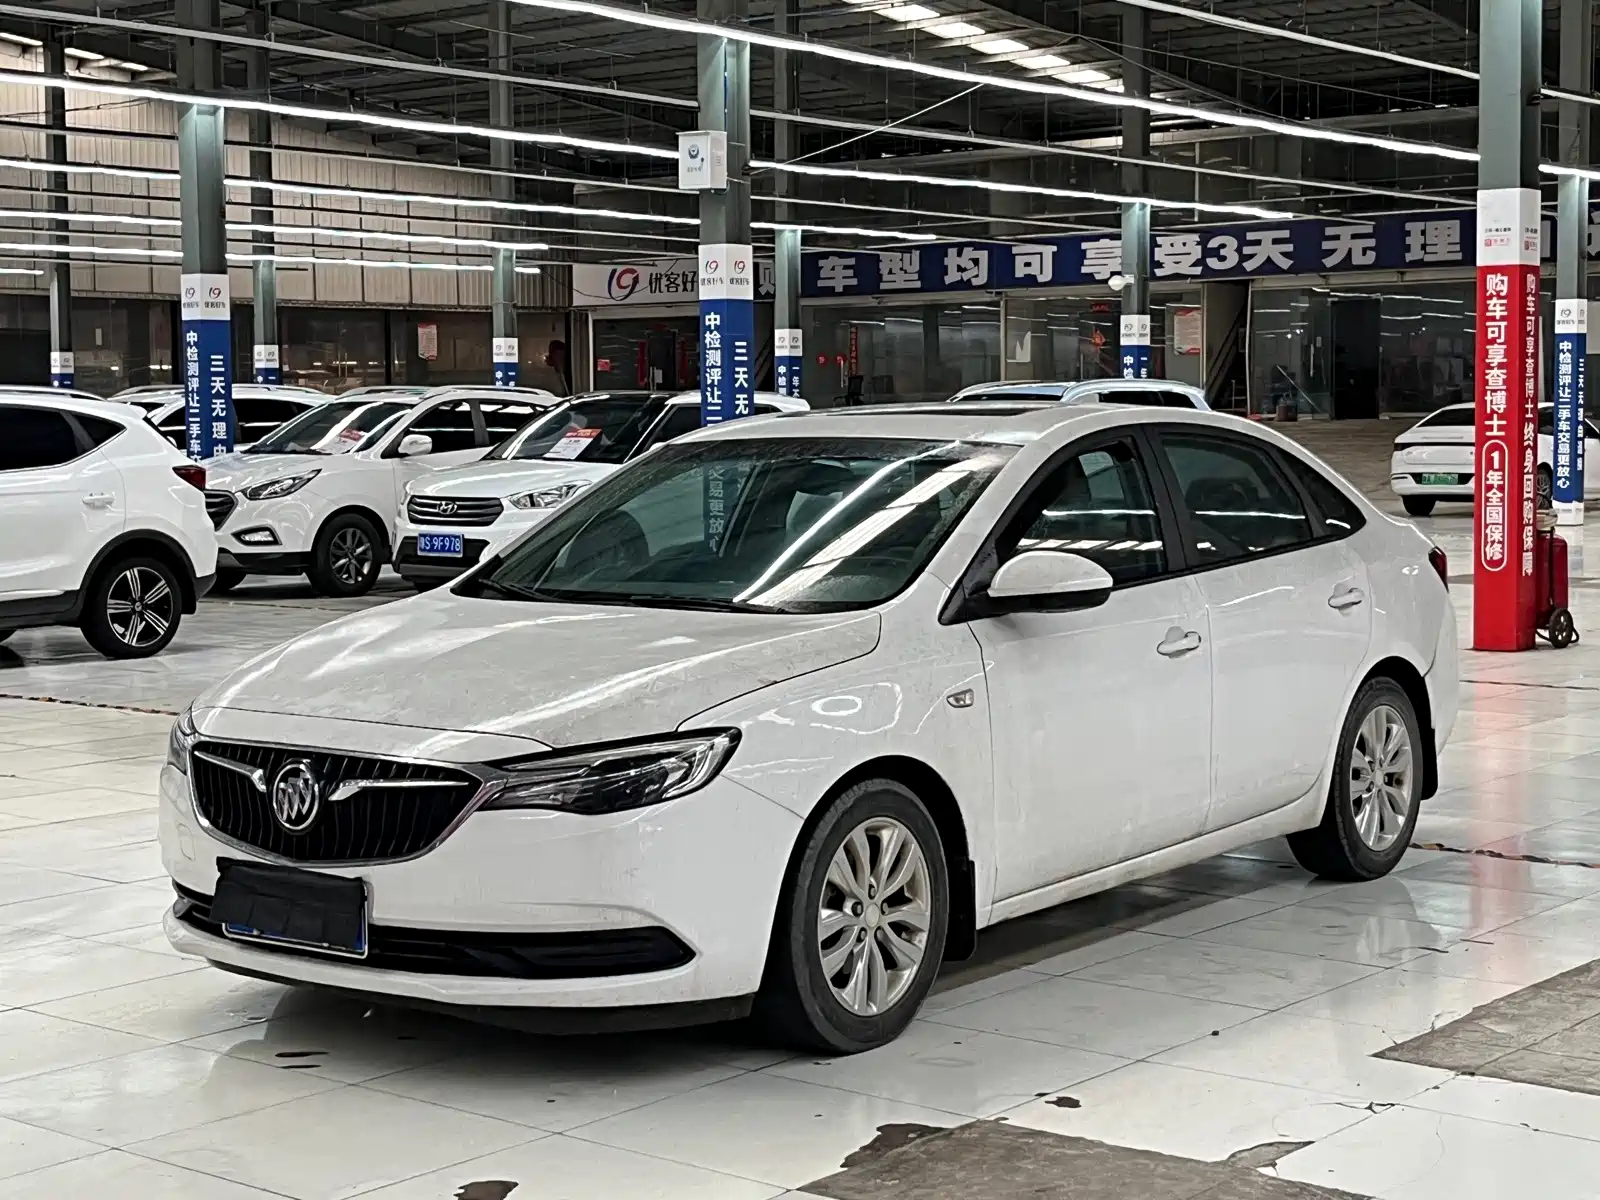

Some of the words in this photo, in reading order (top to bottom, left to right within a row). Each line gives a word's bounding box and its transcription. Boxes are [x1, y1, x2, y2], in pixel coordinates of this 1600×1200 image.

[648, 268, 698, 295] 优客好
[704, 311, 723, 427] 中检测评让二
[733, 341, 749, 415] 三天无
[1484, 273, 1509, 436] 购车可享查博士
[1484, 450, 1504, 561] 1年全国保修
